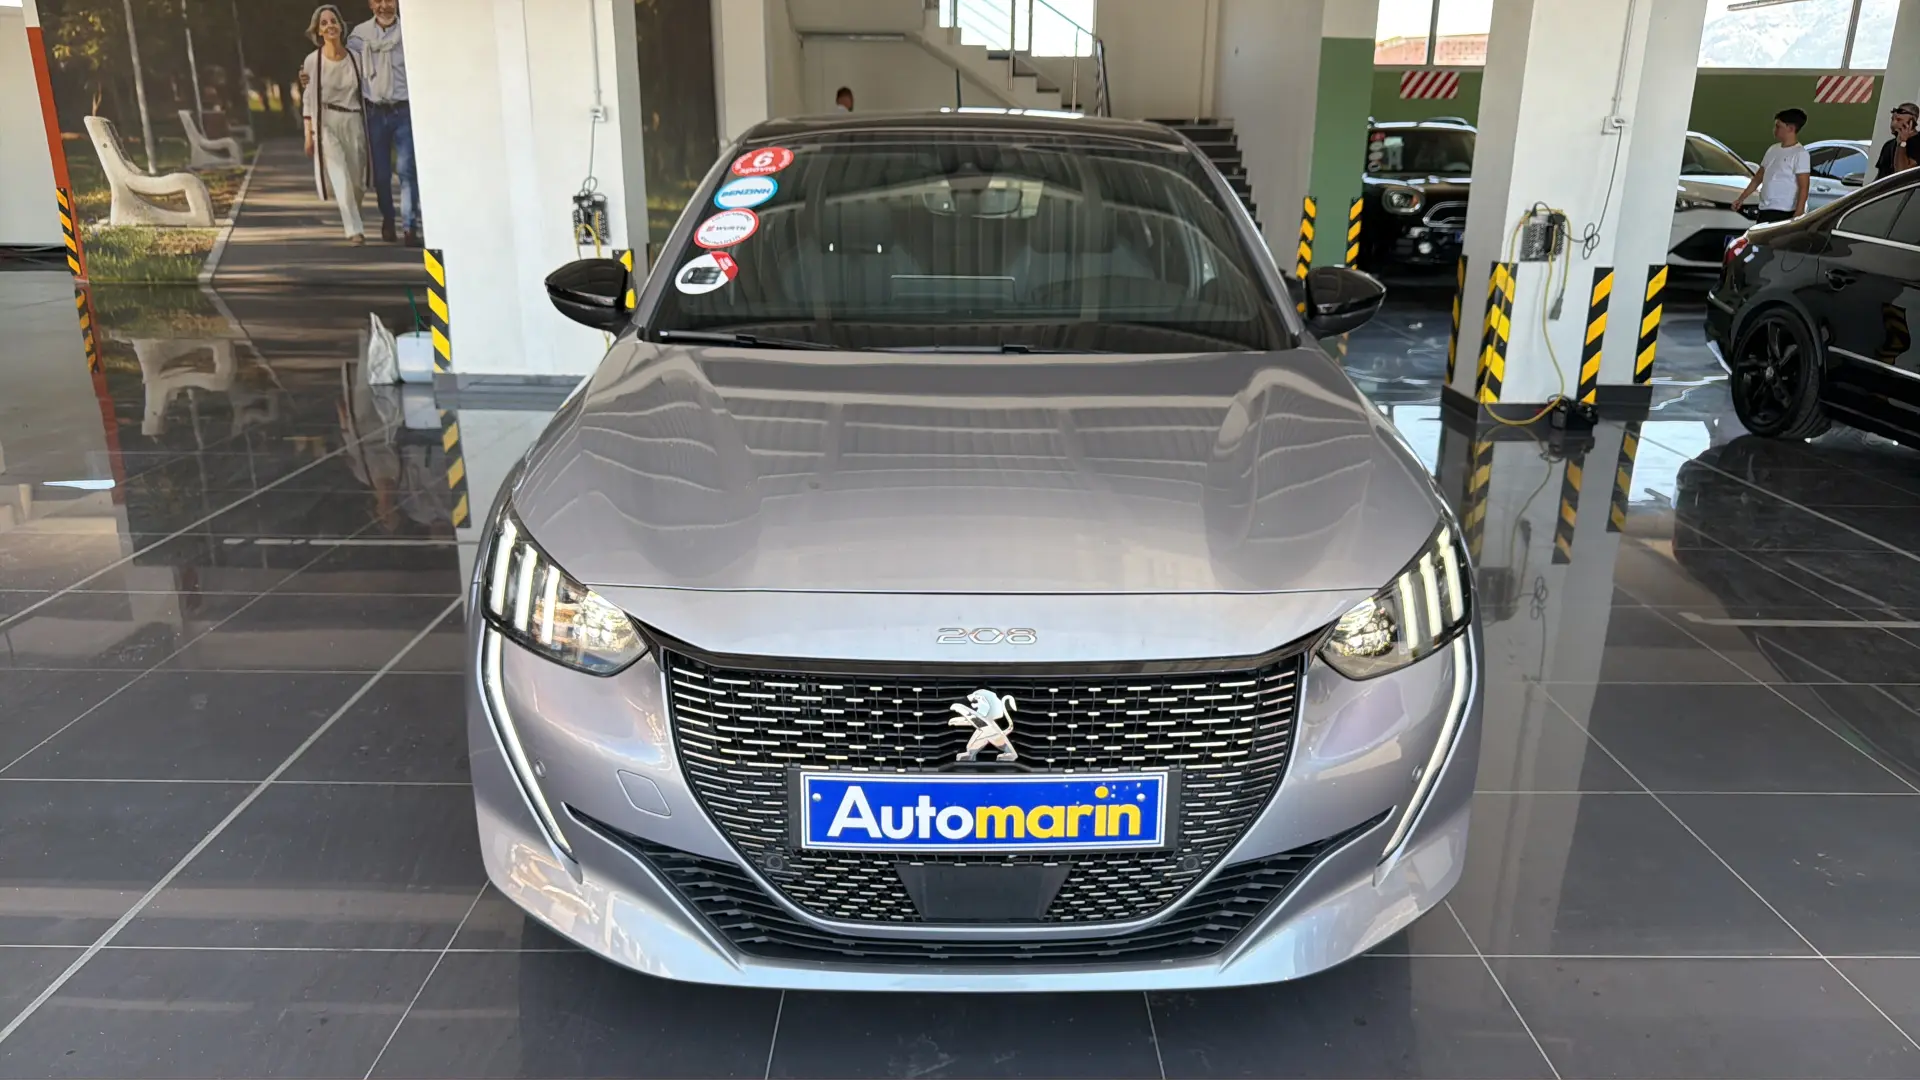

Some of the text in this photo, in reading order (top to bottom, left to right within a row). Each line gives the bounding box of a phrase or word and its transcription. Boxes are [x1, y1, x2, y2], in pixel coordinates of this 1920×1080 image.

[753, 151, 775, 167] 6
[936, 627, 1038, 645] 208
[827, 785, 1141, 839] Automarin
